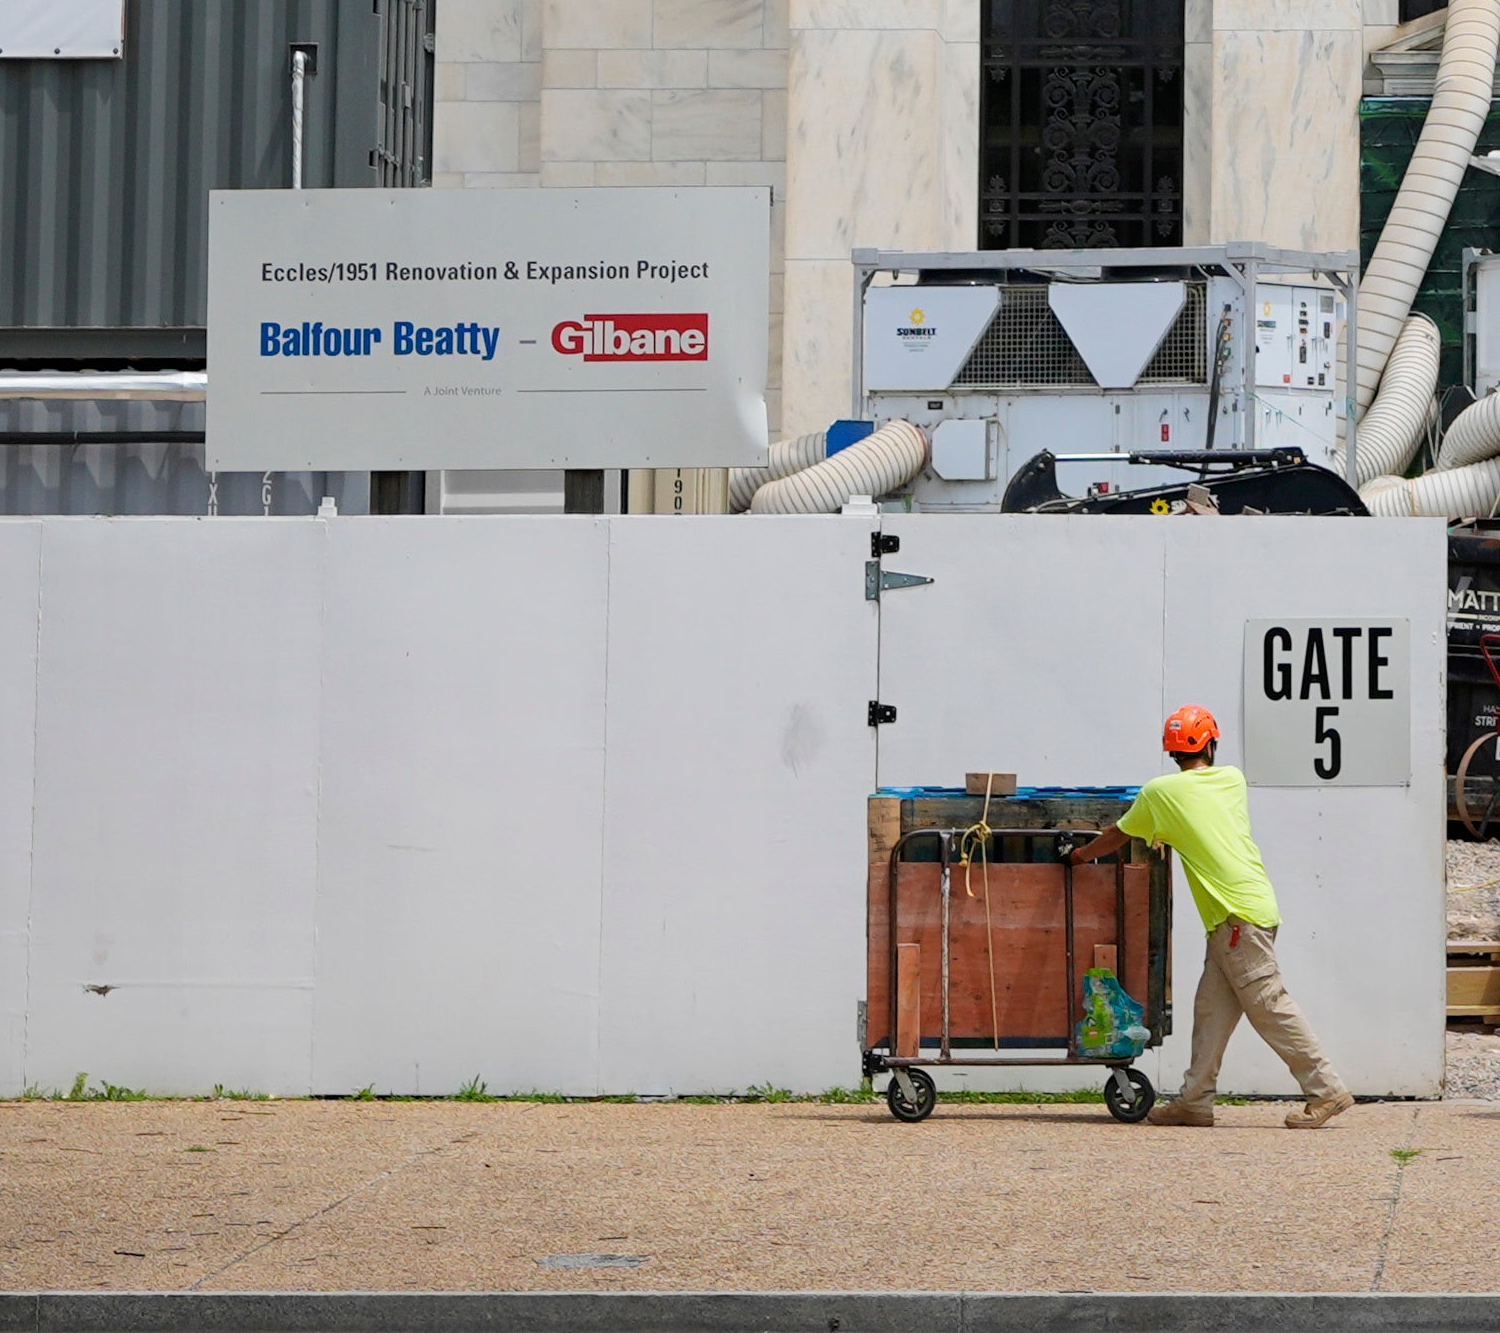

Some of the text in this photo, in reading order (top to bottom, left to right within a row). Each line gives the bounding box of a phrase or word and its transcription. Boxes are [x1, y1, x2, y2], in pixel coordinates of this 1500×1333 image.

[260, 259, 709, 284] Eccles/1951 Renovation & Expansion Project
[259, 319, 707, 360] Balfour Beatty Gilbane
[423, 386, 502, 396] A Joint Venture
[1262, 625, 1394, 702] GATE
[1313, 705, 1342, 780] 5
